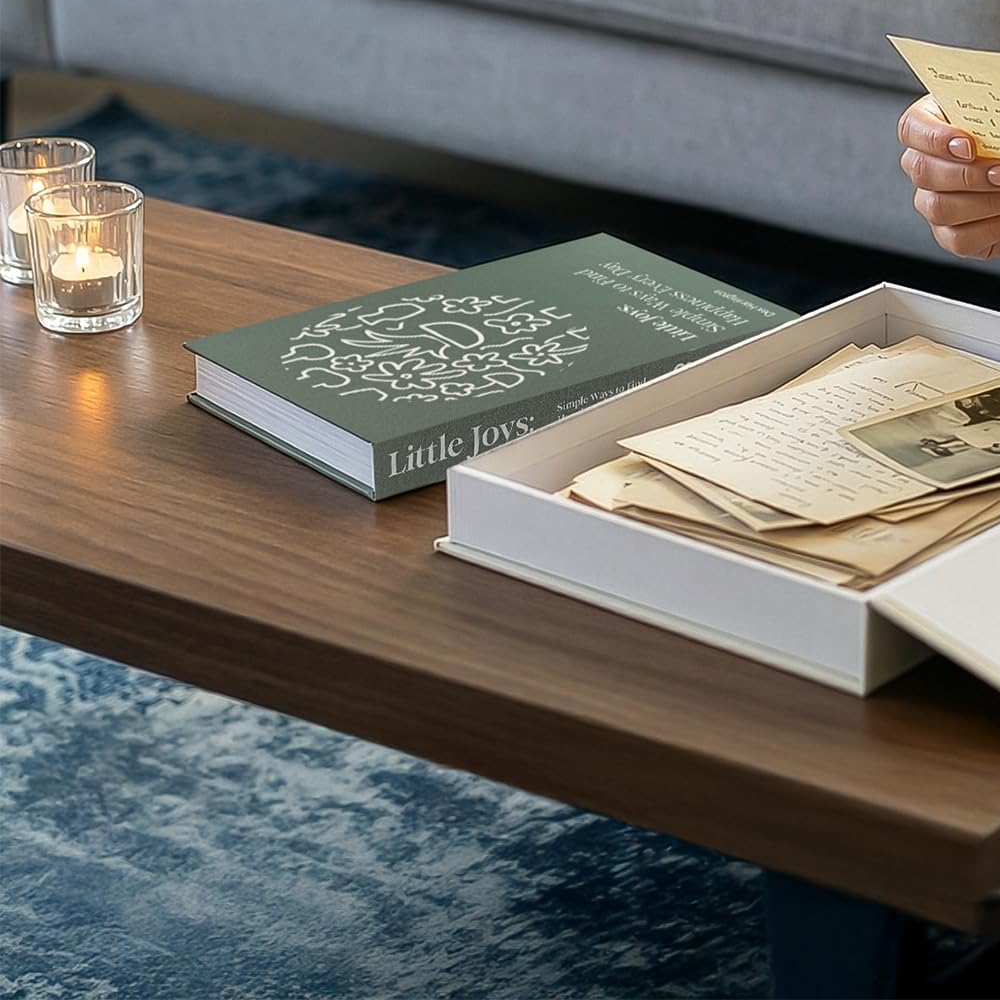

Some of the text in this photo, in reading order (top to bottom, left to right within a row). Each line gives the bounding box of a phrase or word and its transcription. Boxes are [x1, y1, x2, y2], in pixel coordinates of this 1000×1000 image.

[573, 268, 726, 333] Simple Ways to Find
[598, 261, 751, 326] Happiness Every Day
[652, 318, 698, 342] Little
[556, 395, 589, 412] Simple
[590, 389, 614, 401] Ways
[615, 384, 625, 394] to
[388, 432, 464, 478] Little
